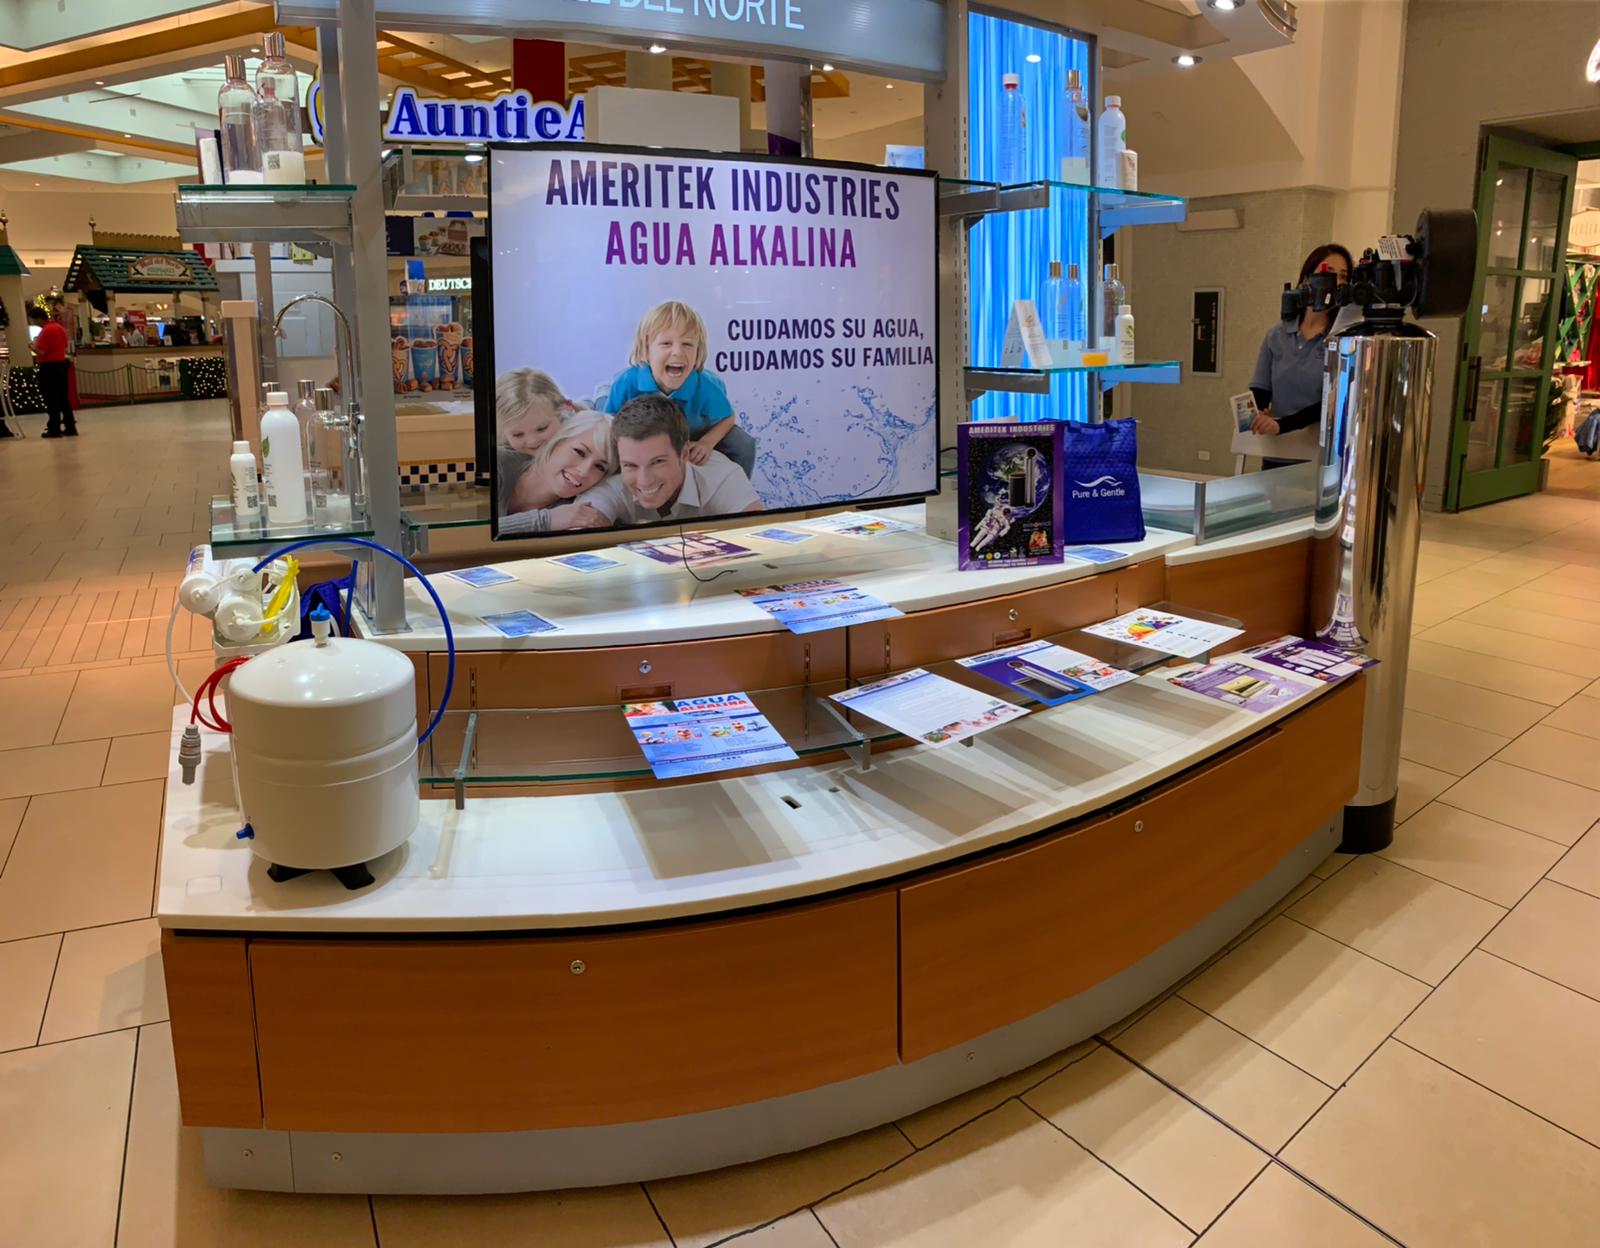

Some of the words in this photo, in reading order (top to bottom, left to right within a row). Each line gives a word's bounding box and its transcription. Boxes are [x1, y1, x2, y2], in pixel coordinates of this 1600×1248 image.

[390, 93, 561, 139] Auntie
[546, 159, 716, 210] AMERITEK
[731, 168, 900, 221] INDUSTRIES
[605, 220, 696, 266] AGUA
[709, 223, 857, 268] ALKALINA
[727, 317, 836, 341] CUIDAMOS
[842, 318, 866, 338] SU
[872, 318, 924, 340] AGUA,
[715, 348, 825, 373] CUIDAMOS
[831, 347, 856, 369] SU
[863, 345, 934, 367] FAMILIA
[968, 426, 1008, 434] AMERITEK
[1009, 424, 1056, 433] INDUSTRIES
[1072, 490, 1090, 499] Pure
[1091, 488, 1099, 498] &
[1100, 488, 1125, 497] Gentle
[677, 694, 741, 707] AGUA
[680, 699, 747, 712] ALKALINA
